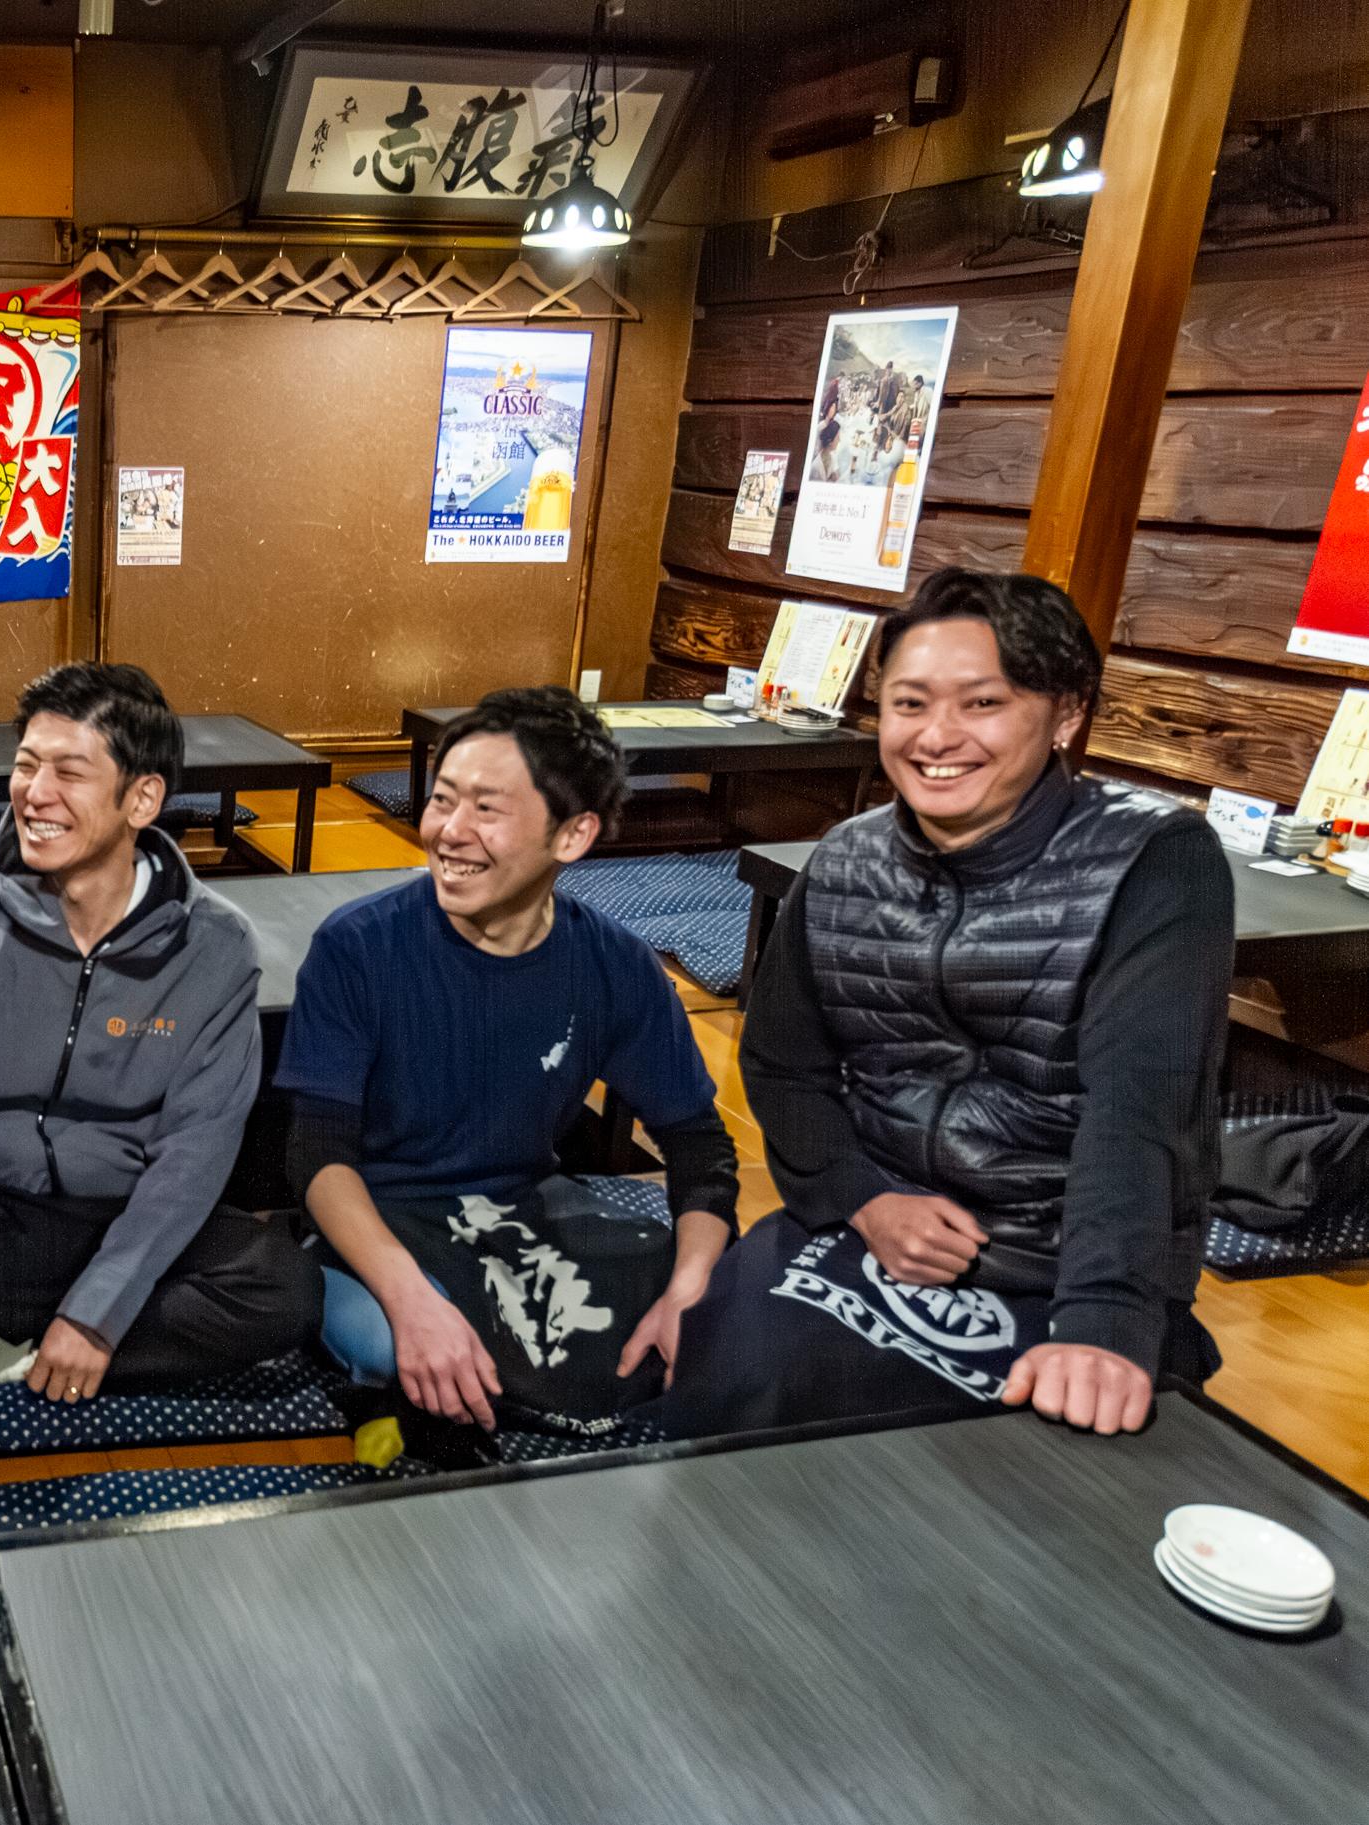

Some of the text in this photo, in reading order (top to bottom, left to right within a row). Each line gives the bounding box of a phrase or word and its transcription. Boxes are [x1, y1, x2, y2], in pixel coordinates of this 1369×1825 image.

[483, 394, 544, 416] CLASSIC
[492, 441, 526, 460] 函館
[7, 443, 62, 547] 大入
[433, 535, 564, 546] The HOKKAIDO BEER
